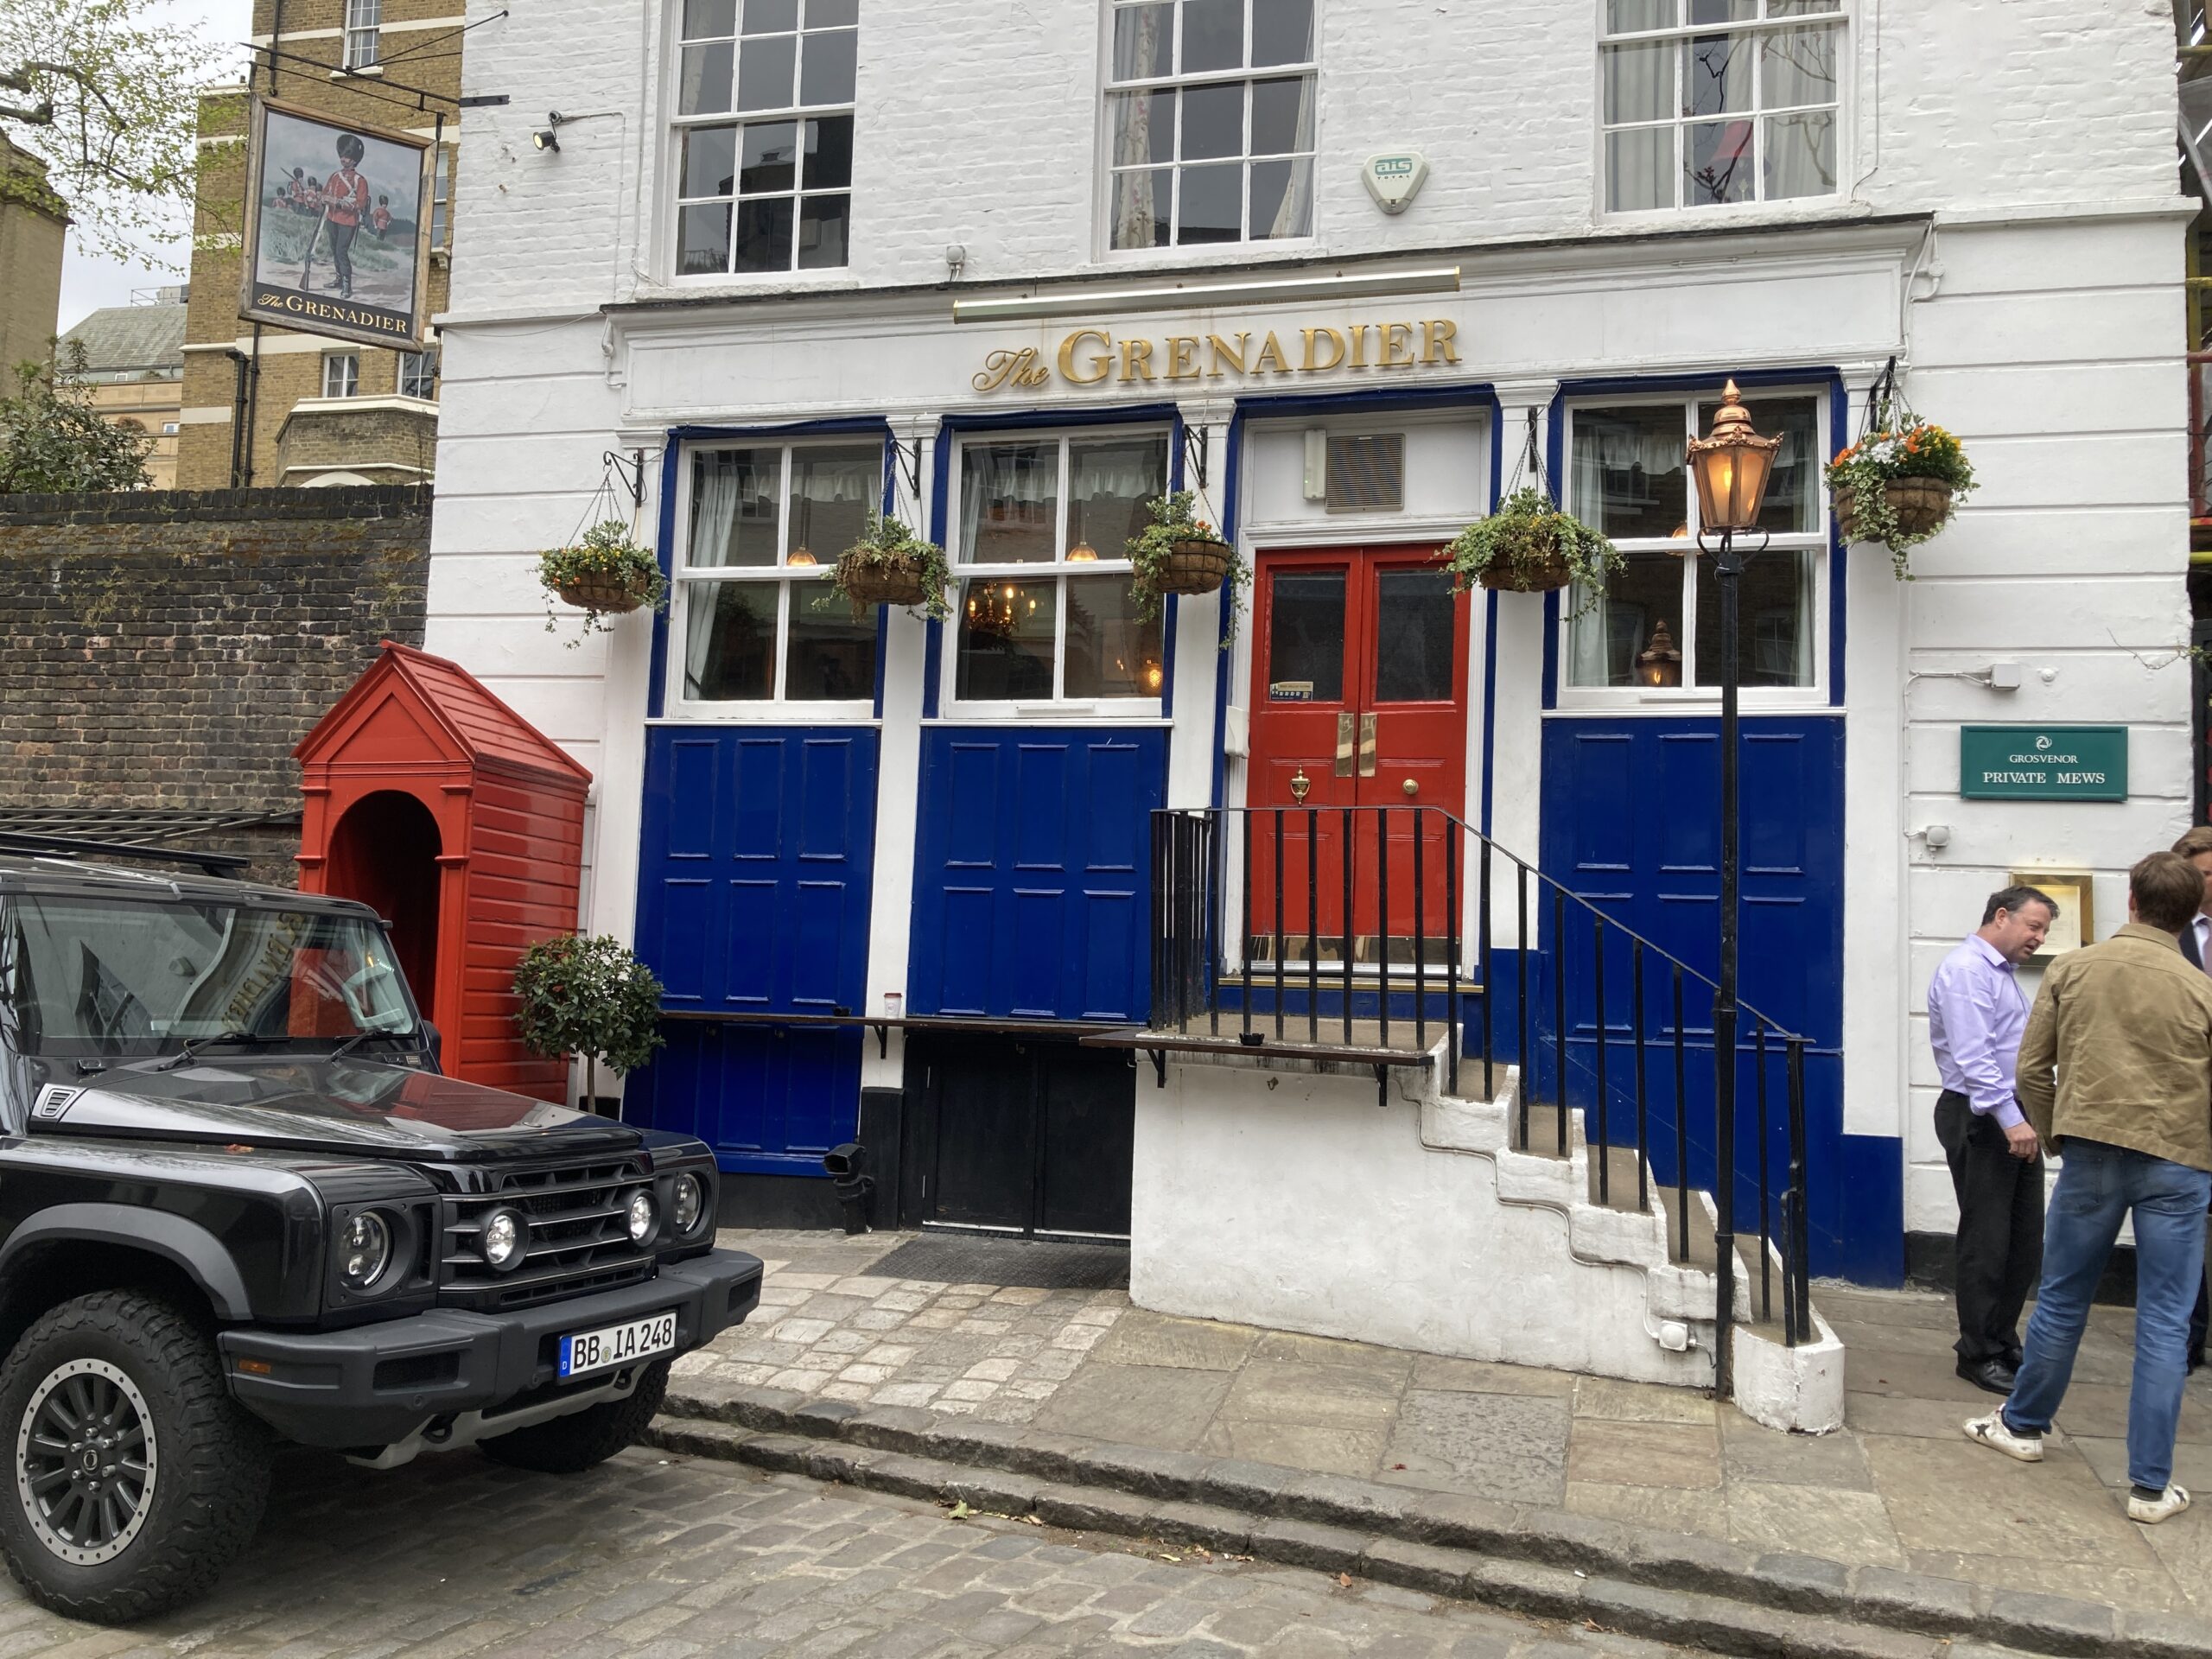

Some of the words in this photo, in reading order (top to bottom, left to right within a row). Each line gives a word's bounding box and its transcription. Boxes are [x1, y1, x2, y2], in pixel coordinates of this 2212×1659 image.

[257, 293, 283, 309] The
[286, 295, 407, 334] GRENADIER
[971, 346, 1050, 391] The
[1057, 319, 1462, 384] GRENADIER
[2009, 754, 2078, 764] GROSVENOR
[1983, 772, 2046, 784] PRIVATE
[2056, 772, 2105, 784] MEWS
[574, 1335, 600, 1370] BB
[639, 1318, 672, 1353] 248
[562, 1361, 568, 1370] D
